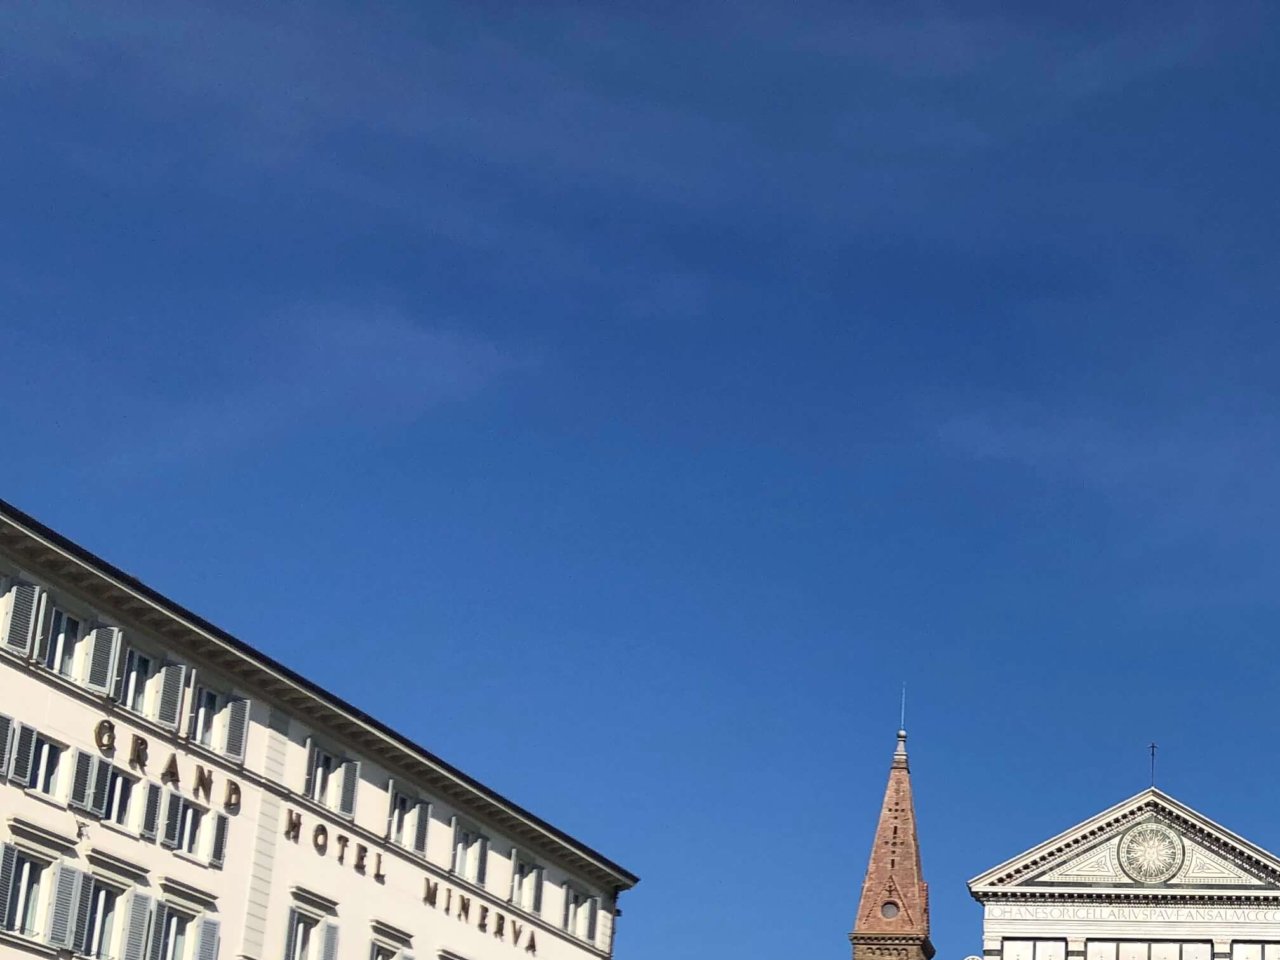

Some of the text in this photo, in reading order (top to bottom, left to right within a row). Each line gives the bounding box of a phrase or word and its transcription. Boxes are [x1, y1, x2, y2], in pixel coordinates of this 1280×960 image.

[94, 719, 241, 812] GRAND
[284, 808, 537, 955] HOTEL MINERVA
